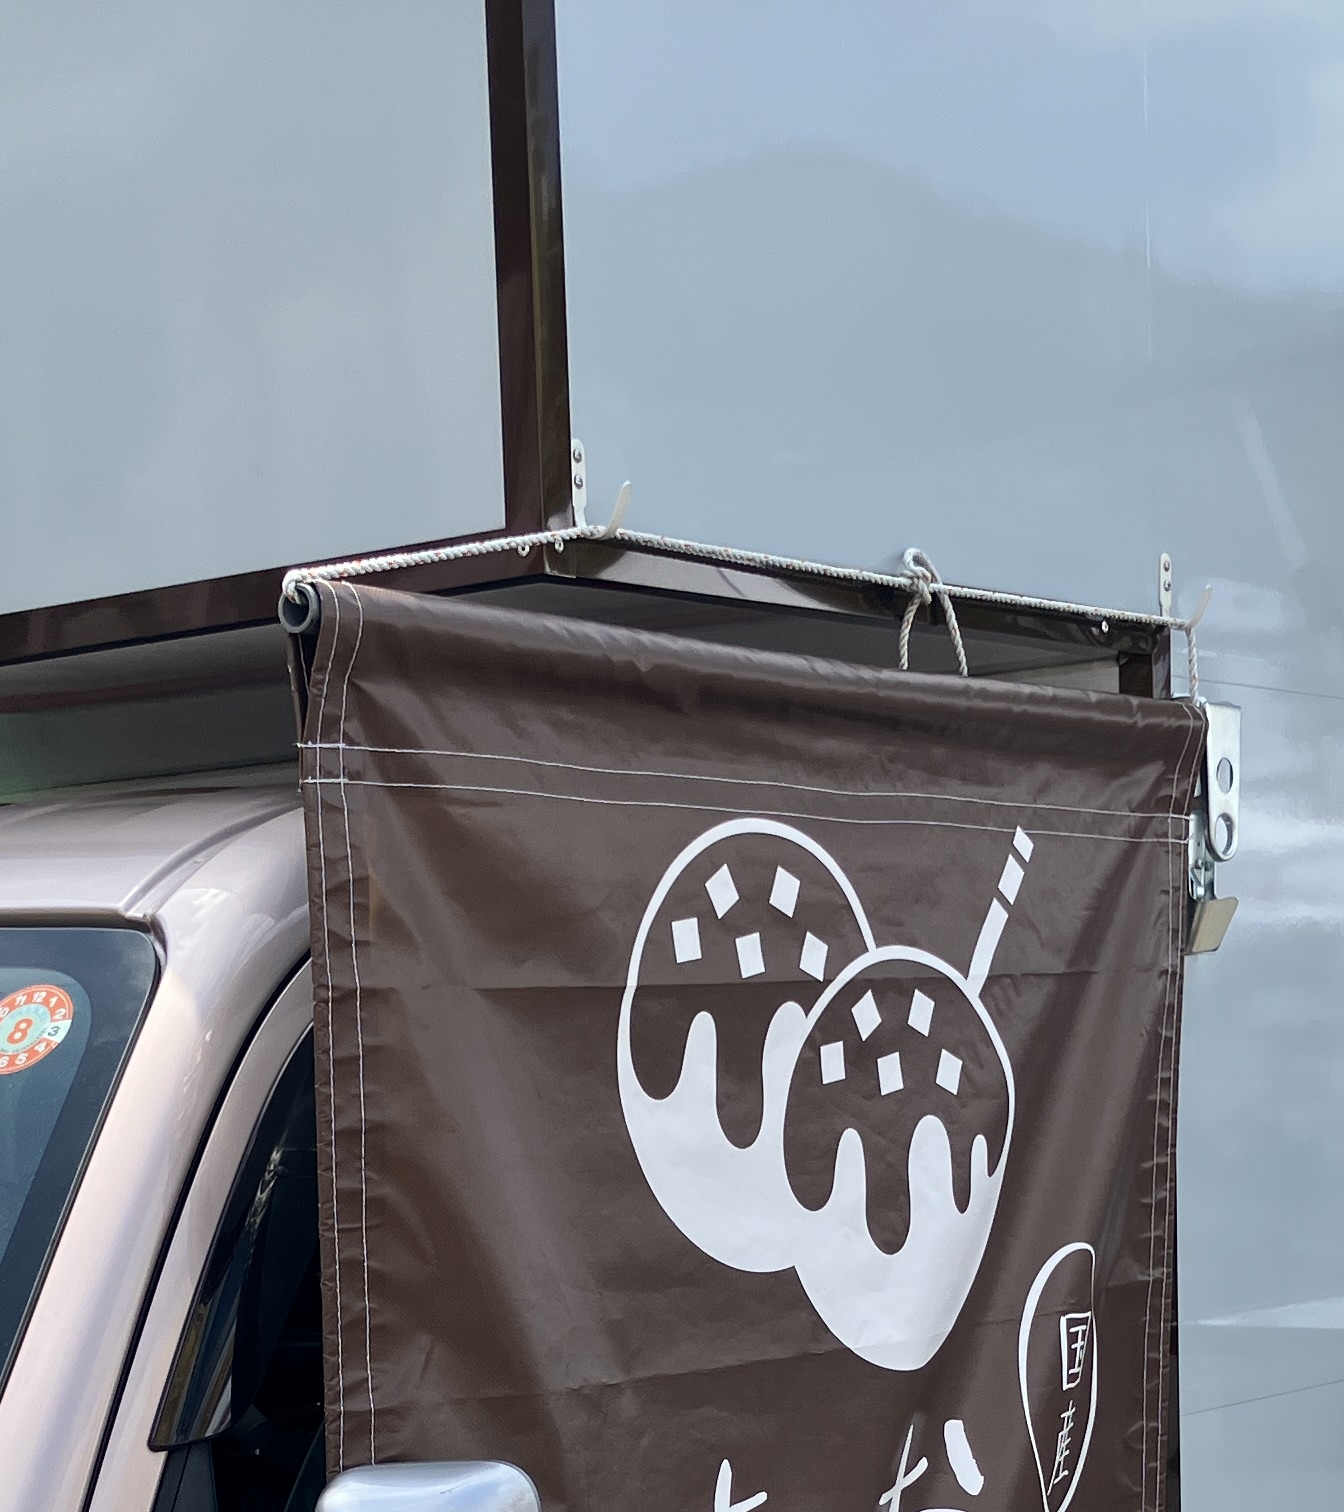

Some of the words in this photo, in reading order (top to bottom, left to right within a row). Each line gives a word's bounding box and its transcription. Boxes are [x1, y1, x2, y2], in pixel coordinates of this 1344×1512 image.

[6, 1017, 34, 1045] 8
[32, 991, 47, 1003] 12
[47, 1026, 61, 1037] 3
[1046, 1310, 1093, 1497] 国産
